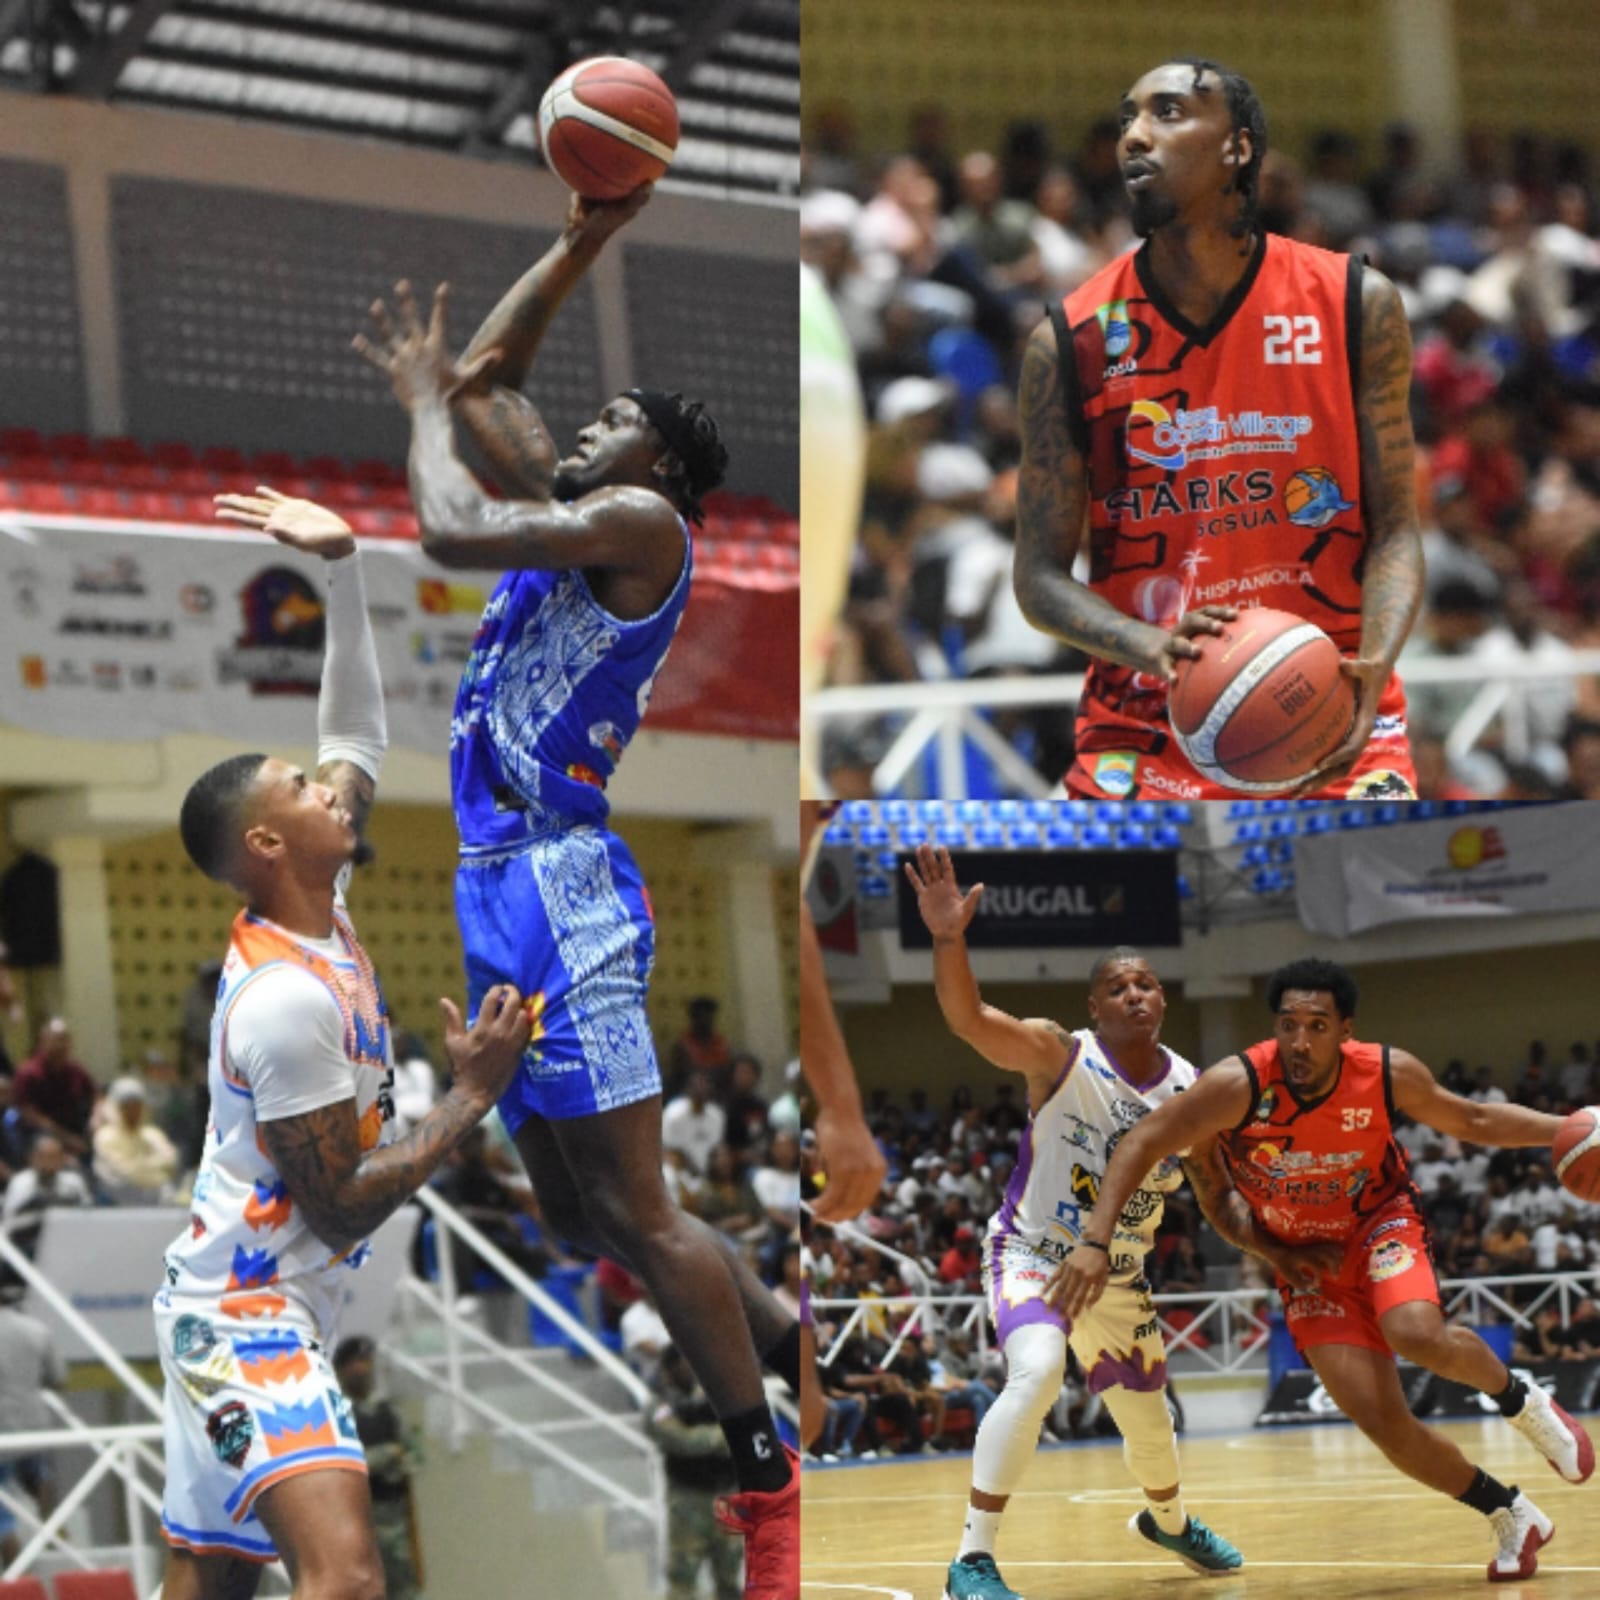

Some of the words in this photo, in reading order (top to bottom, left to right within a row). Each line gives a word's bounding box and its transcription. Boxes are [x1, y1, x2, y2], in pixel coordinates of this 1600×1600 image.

[1263, 315, 1323, 364] 22
[1228, 411, 1312, 441] Village
[1195, 568, 1315, 602] HISPANIOLA
[966, 884, 1095, 917] RUGAL
